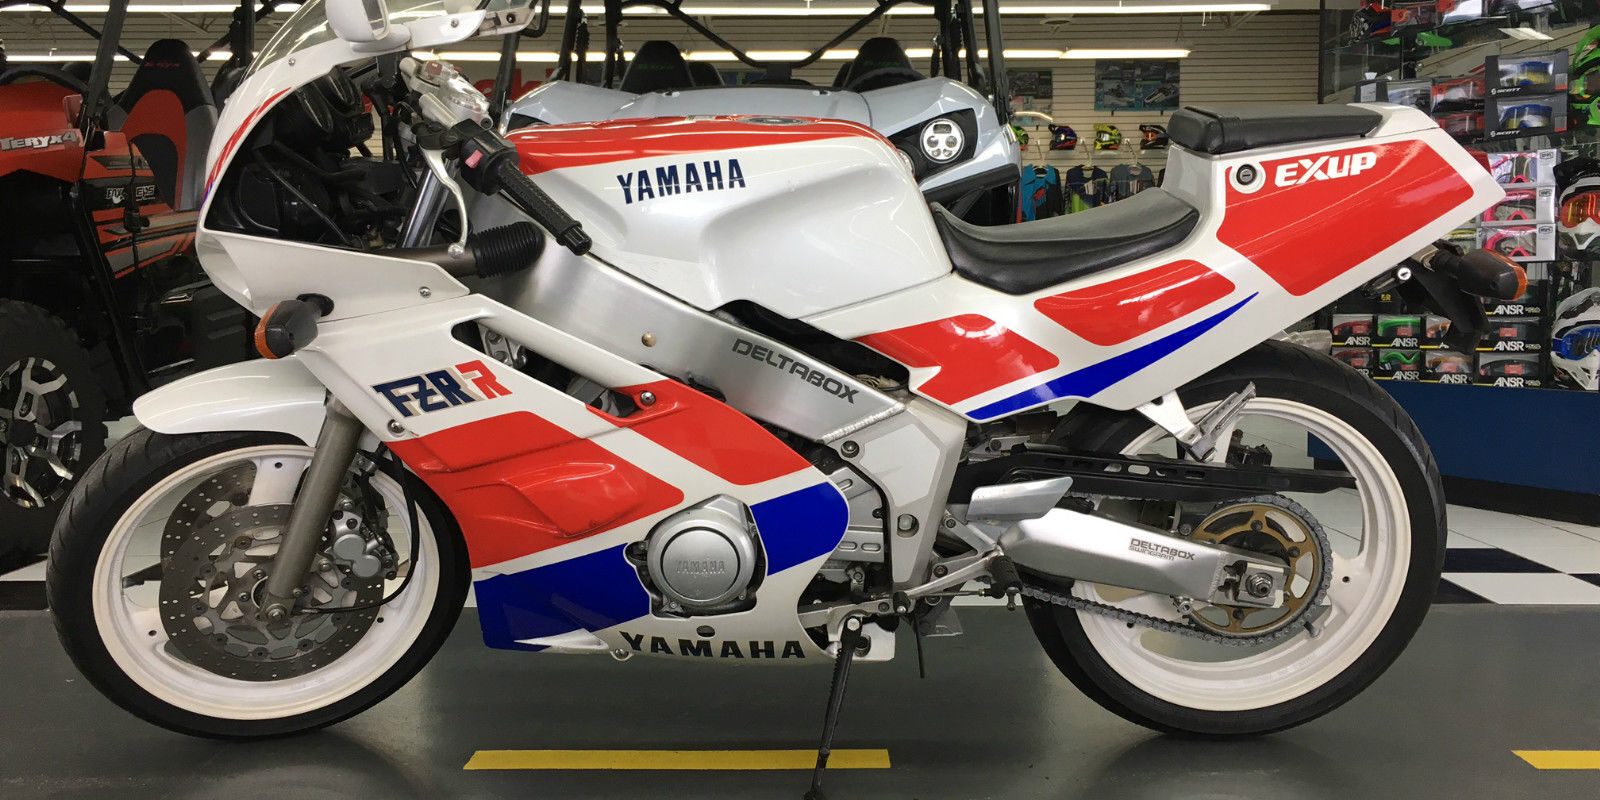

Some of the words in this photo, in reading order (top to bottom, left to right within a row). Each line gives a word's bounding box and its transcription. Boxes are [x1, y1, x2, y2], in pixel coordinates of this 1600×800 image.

[1274, 151, 1377, 188] EXUP
[616, 158, 746, 204] YAMAHA
[1494, 304, 1524, 315] ANSR
[1345, 336, 1371, 346] ANSR
[1391, 338, 1419, 347] ANSR
[1494, 340, 1525, 351] ANSR
[731, 338, 860, 405] DELTABOX
[1391, 370, 1420, 381] ANSR
[1439, 373, 1468, 384] ANSR
[1494, 376, 1525, 388] ANSR
[1129, 538, 1196, 561] DELTABOX
[676, 559, 726, 574] YAMAHA
[619, 630, 806, 659] YAMAHA
